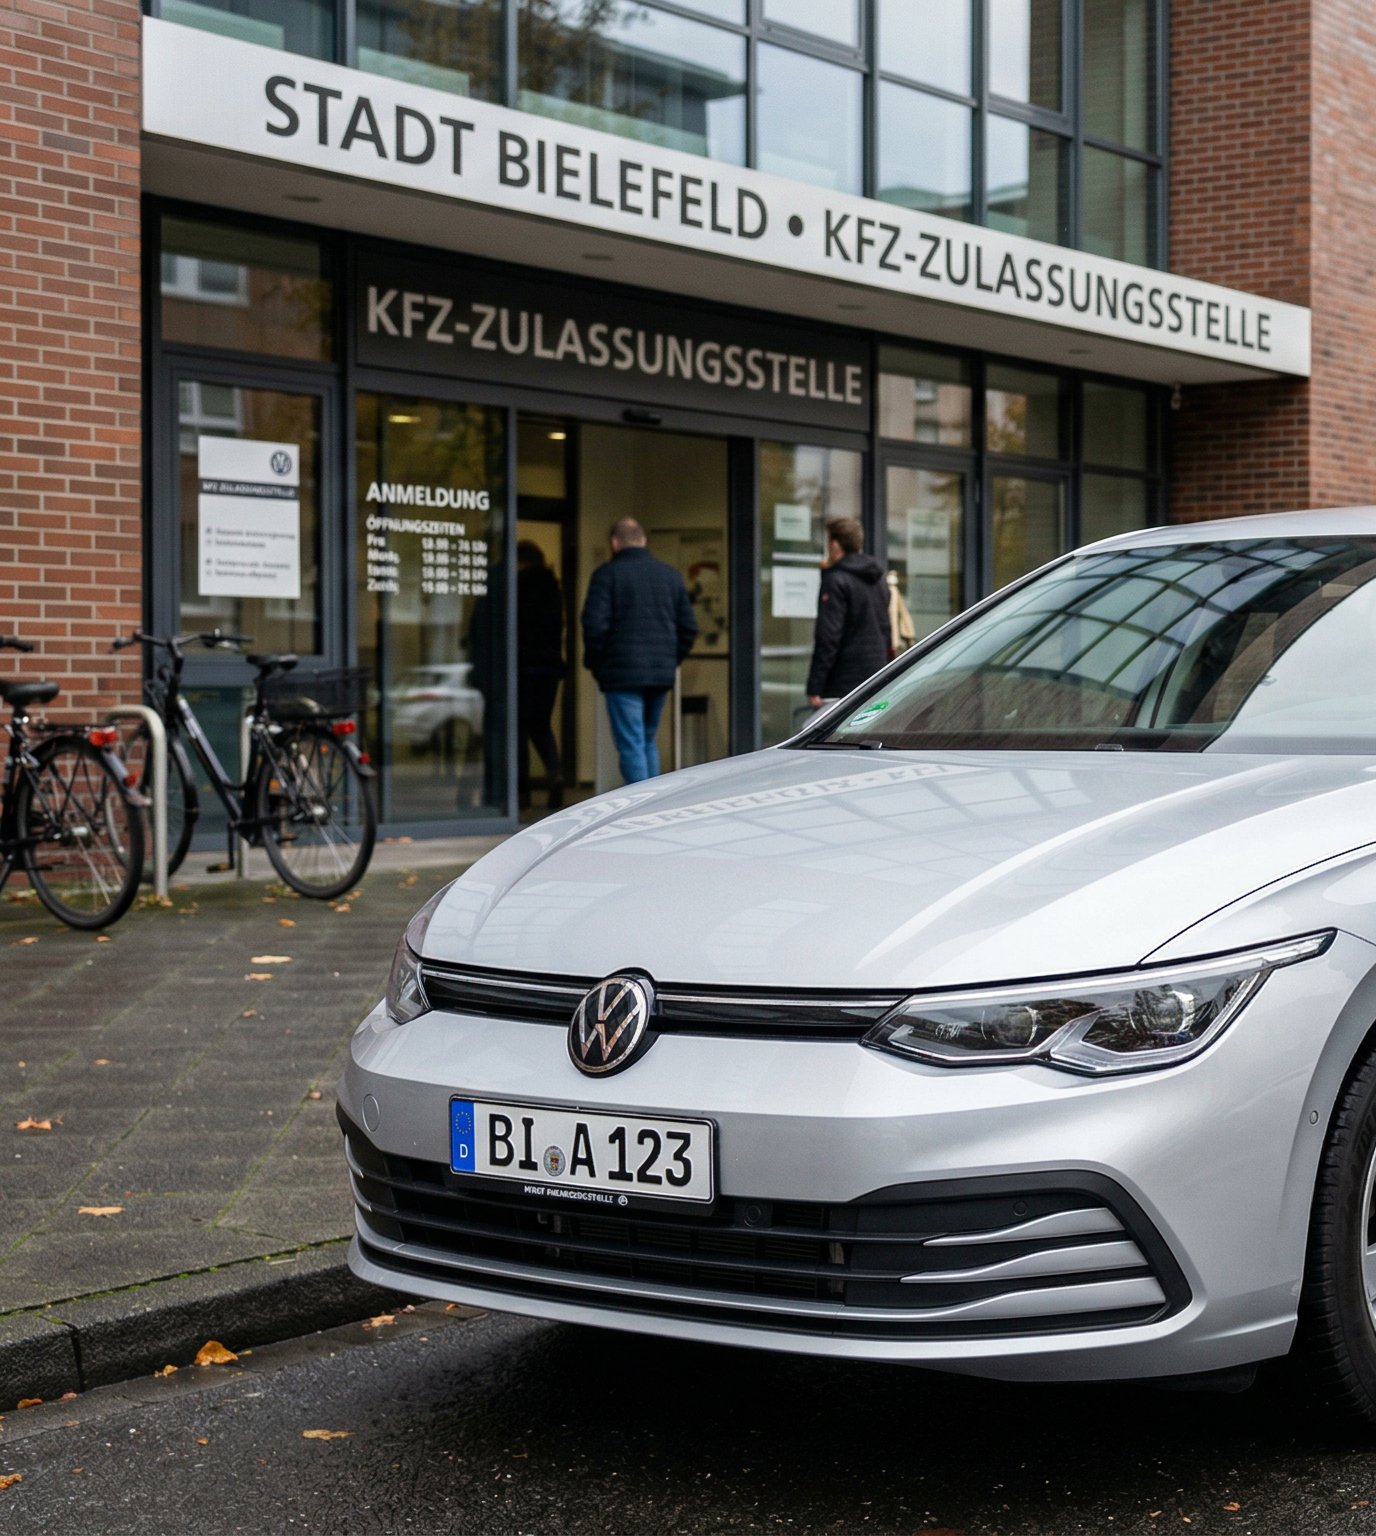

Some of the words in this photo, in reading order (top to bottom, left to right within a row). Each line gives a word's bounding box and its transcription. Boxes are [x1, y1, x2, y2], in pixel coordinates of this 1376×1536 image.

[264, 75, 475, 176] STADT
[499, 128, 769, 240] BIELEFELD
[823, 209, 1272, 353] KFZ-ZULASSUNGSSTELLE
[366, 286, 863, 405] KFZ-ZULASSUNGSSTELLE
[366, 481, 490, 511] ANMELDUNG
[459, 1143, 469, 1159] D
[608, 1126, 693, 1187] 123
